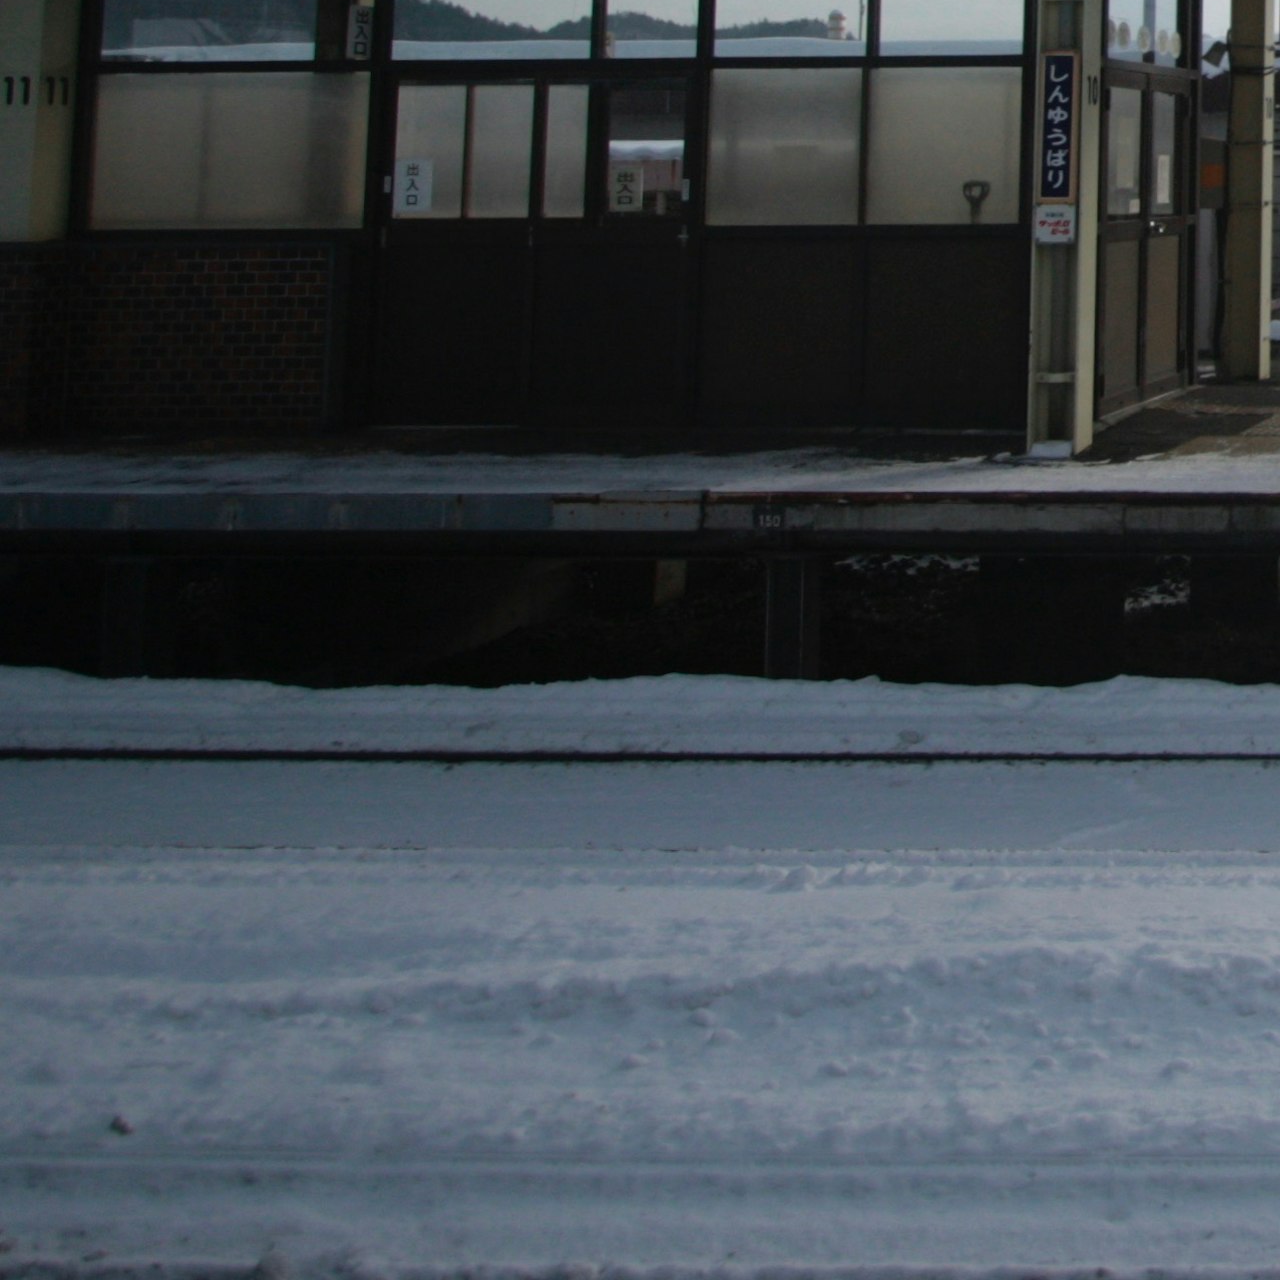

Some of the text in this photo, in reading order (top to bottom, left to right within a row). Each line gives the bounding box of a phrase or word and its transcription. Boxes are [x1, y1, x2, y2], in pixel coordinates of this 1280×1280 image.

[354, 10, 369, 55] 出入口
[4, 76, 31, 105] 11
[46, 76, 69, 105] 11
[1046, 64, 1070, 189] しんゆうばり
[406, 163, 419, 206] 出入口
[616, 172, 634, 205] 出入口
[759, 514, 781, 528] 150
